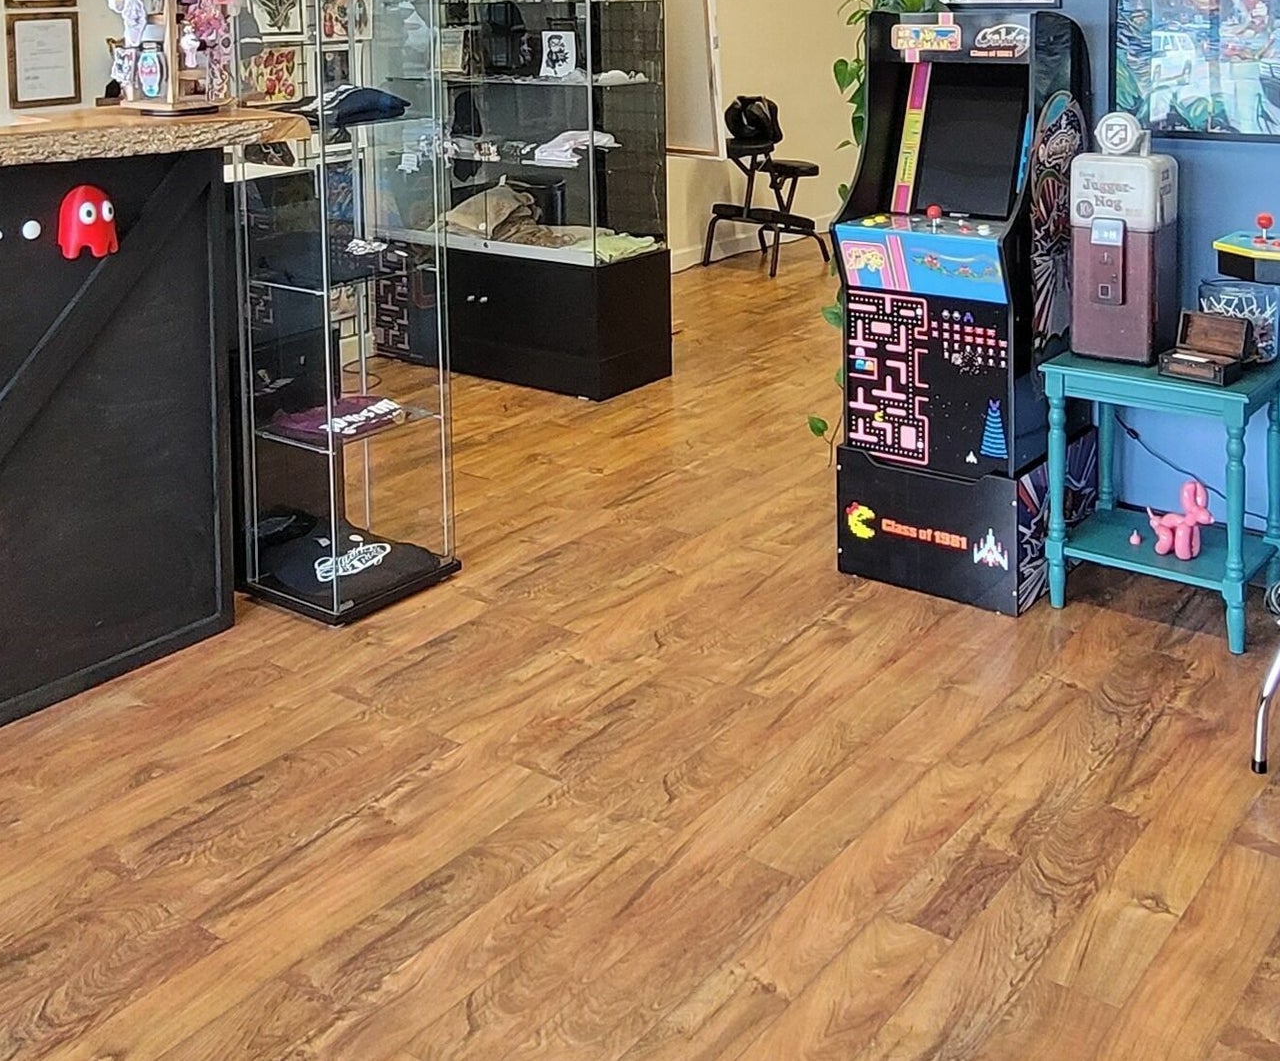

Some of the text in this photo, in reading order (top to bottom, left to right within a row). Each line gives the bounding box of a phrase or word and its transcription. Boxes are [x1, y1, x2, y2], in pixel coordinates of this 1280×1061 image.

[1094, 195, 1123, 212] Nog
[881, 518, 967, 550] Class of 1981
